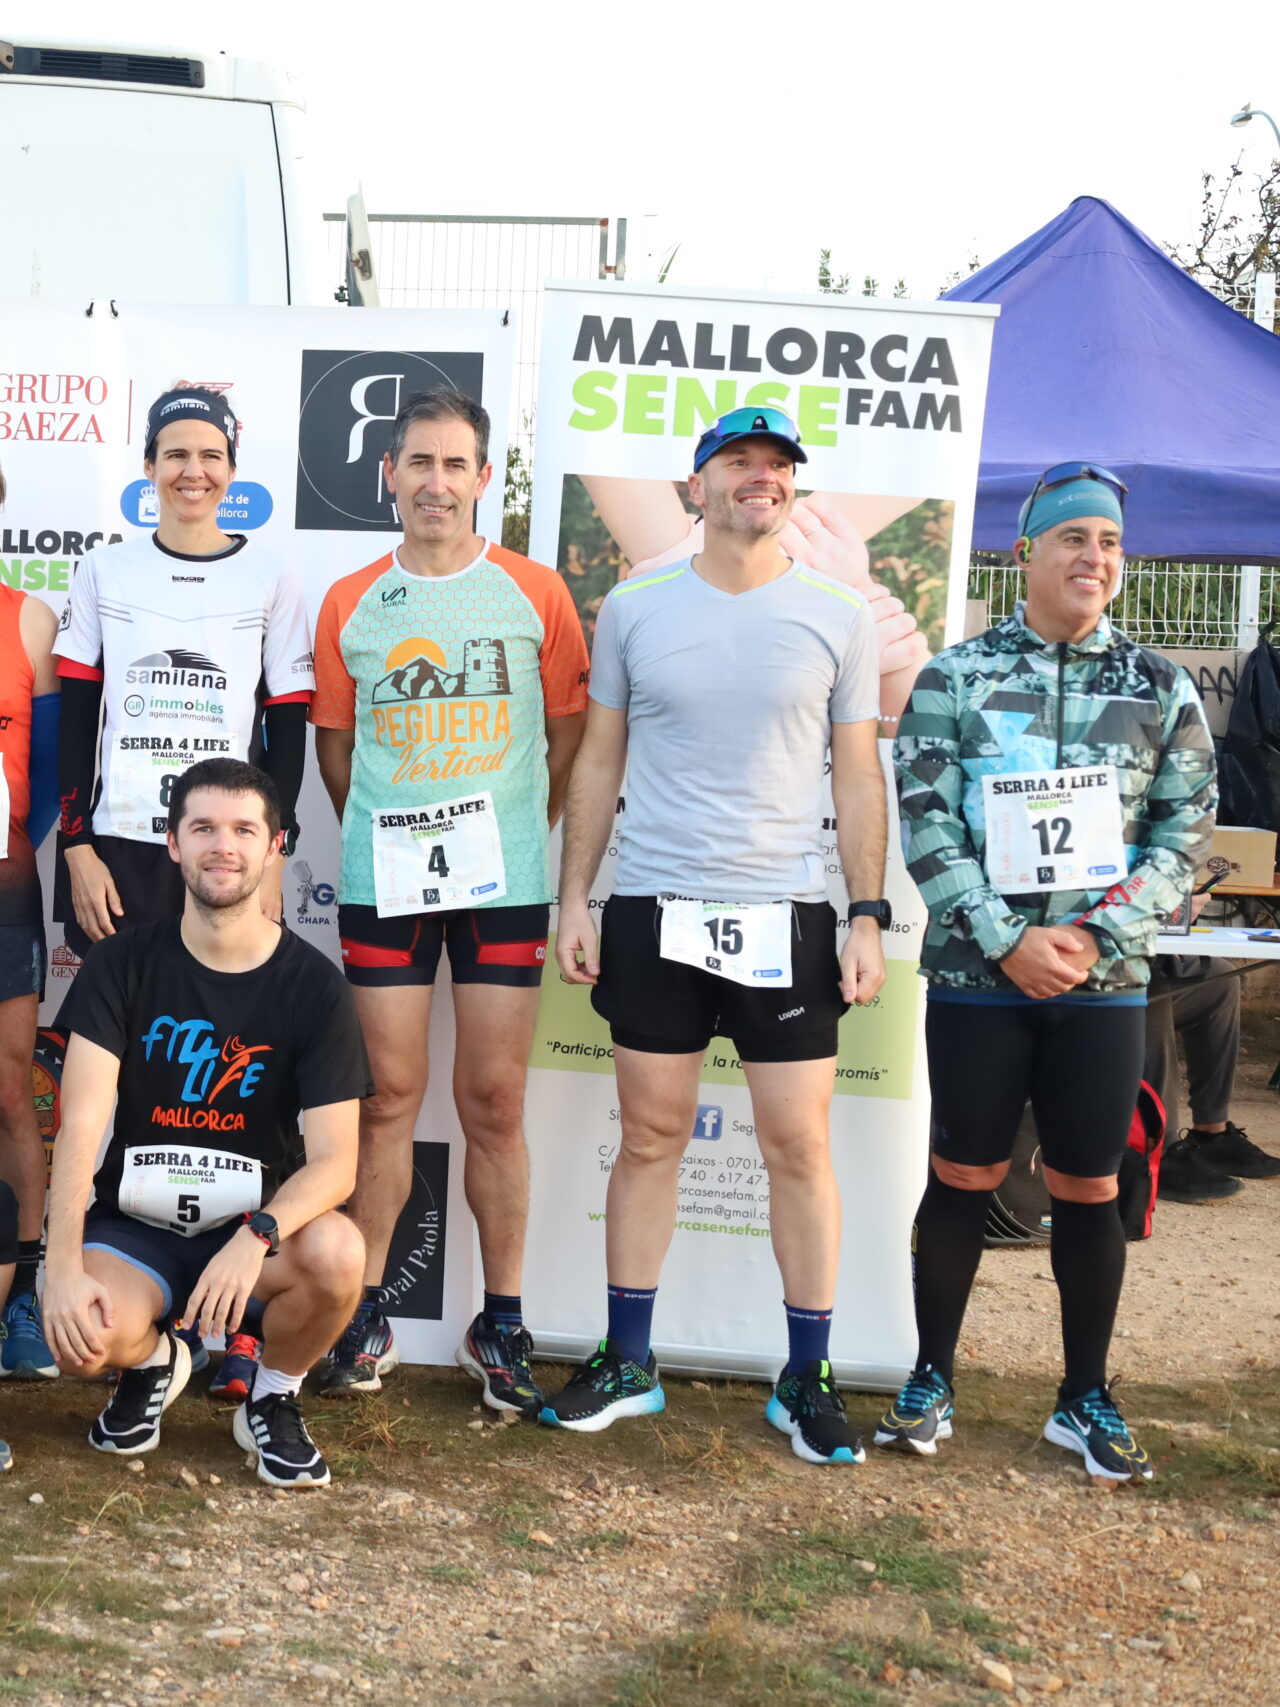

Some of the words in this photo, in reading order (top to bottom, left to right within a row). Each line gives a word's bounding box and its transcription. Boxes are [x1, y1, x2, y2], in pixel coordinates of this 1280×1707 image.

[572, 314, 959, 386] MALLORCA
[160, 402, 210, 416] samilana
[846, 387, 962, 432] FAM
[236, 494, 250, 505] de
[216, 508, 248, 519] allorca
[381, 601, 407, 609] SURAL
[125, 669, 227, 691] samilana
[127, 700, 142, 711] GR
[150, 695, 224, 715] immobles
[149, 711, 179, 720] agència
[371, 699, 511, 747] PEGUERA
[120, 737, 172, 750] SERRA
[178, 737, 188, 750] 4
[193, 738, 230, 752] LIFE
[151, 751, 194, 759] MALLORCA
[151, 758, 180, 766] SENSE
[392, 736, 514, 784] Vertical
[992, 778, 1050, 795] SERRA
[1055, 777, 1065, 790] 4
[1070, 773, 1108, 789] LIFE
[1027, 792, 1072, 801] MALLORCA
[1027, 800, 1059, 810] SENSE
[380, 812, 431, 828] SERRA
[435, 809, 445, 819] 4
[410, 819, 454, 832] MALLORCA
[411, 830, 442, 840] SENSE
[1032, 817, 1074, 856] 12
[428, 845, 450, 878] 4
[297, 916, 331, 925] CHAPA
[703, 917, 744, 955] 15
[713, 1056, 727, 1068] la
[152, 1106, 245, 1131] MALLORCA
[133, 1152, 194, 1167] SERRA
[198, 1155, 209, 1168] 4
[214, 1157, 253, 1173] LIFE
[168, 1168, 215, 1177] MALLORCA
[690, 1170, 706, 1181] 40
[717, 1172, 743, 1184] 617
[746, 1174, 763, 1185] 47
[168, 1176, 200, 1185] SENSE
[177, 1194, 201, 1224] 5
[377, 1266, 417, 1305] oyal
[408, 1210, 439, 1269] Paola
